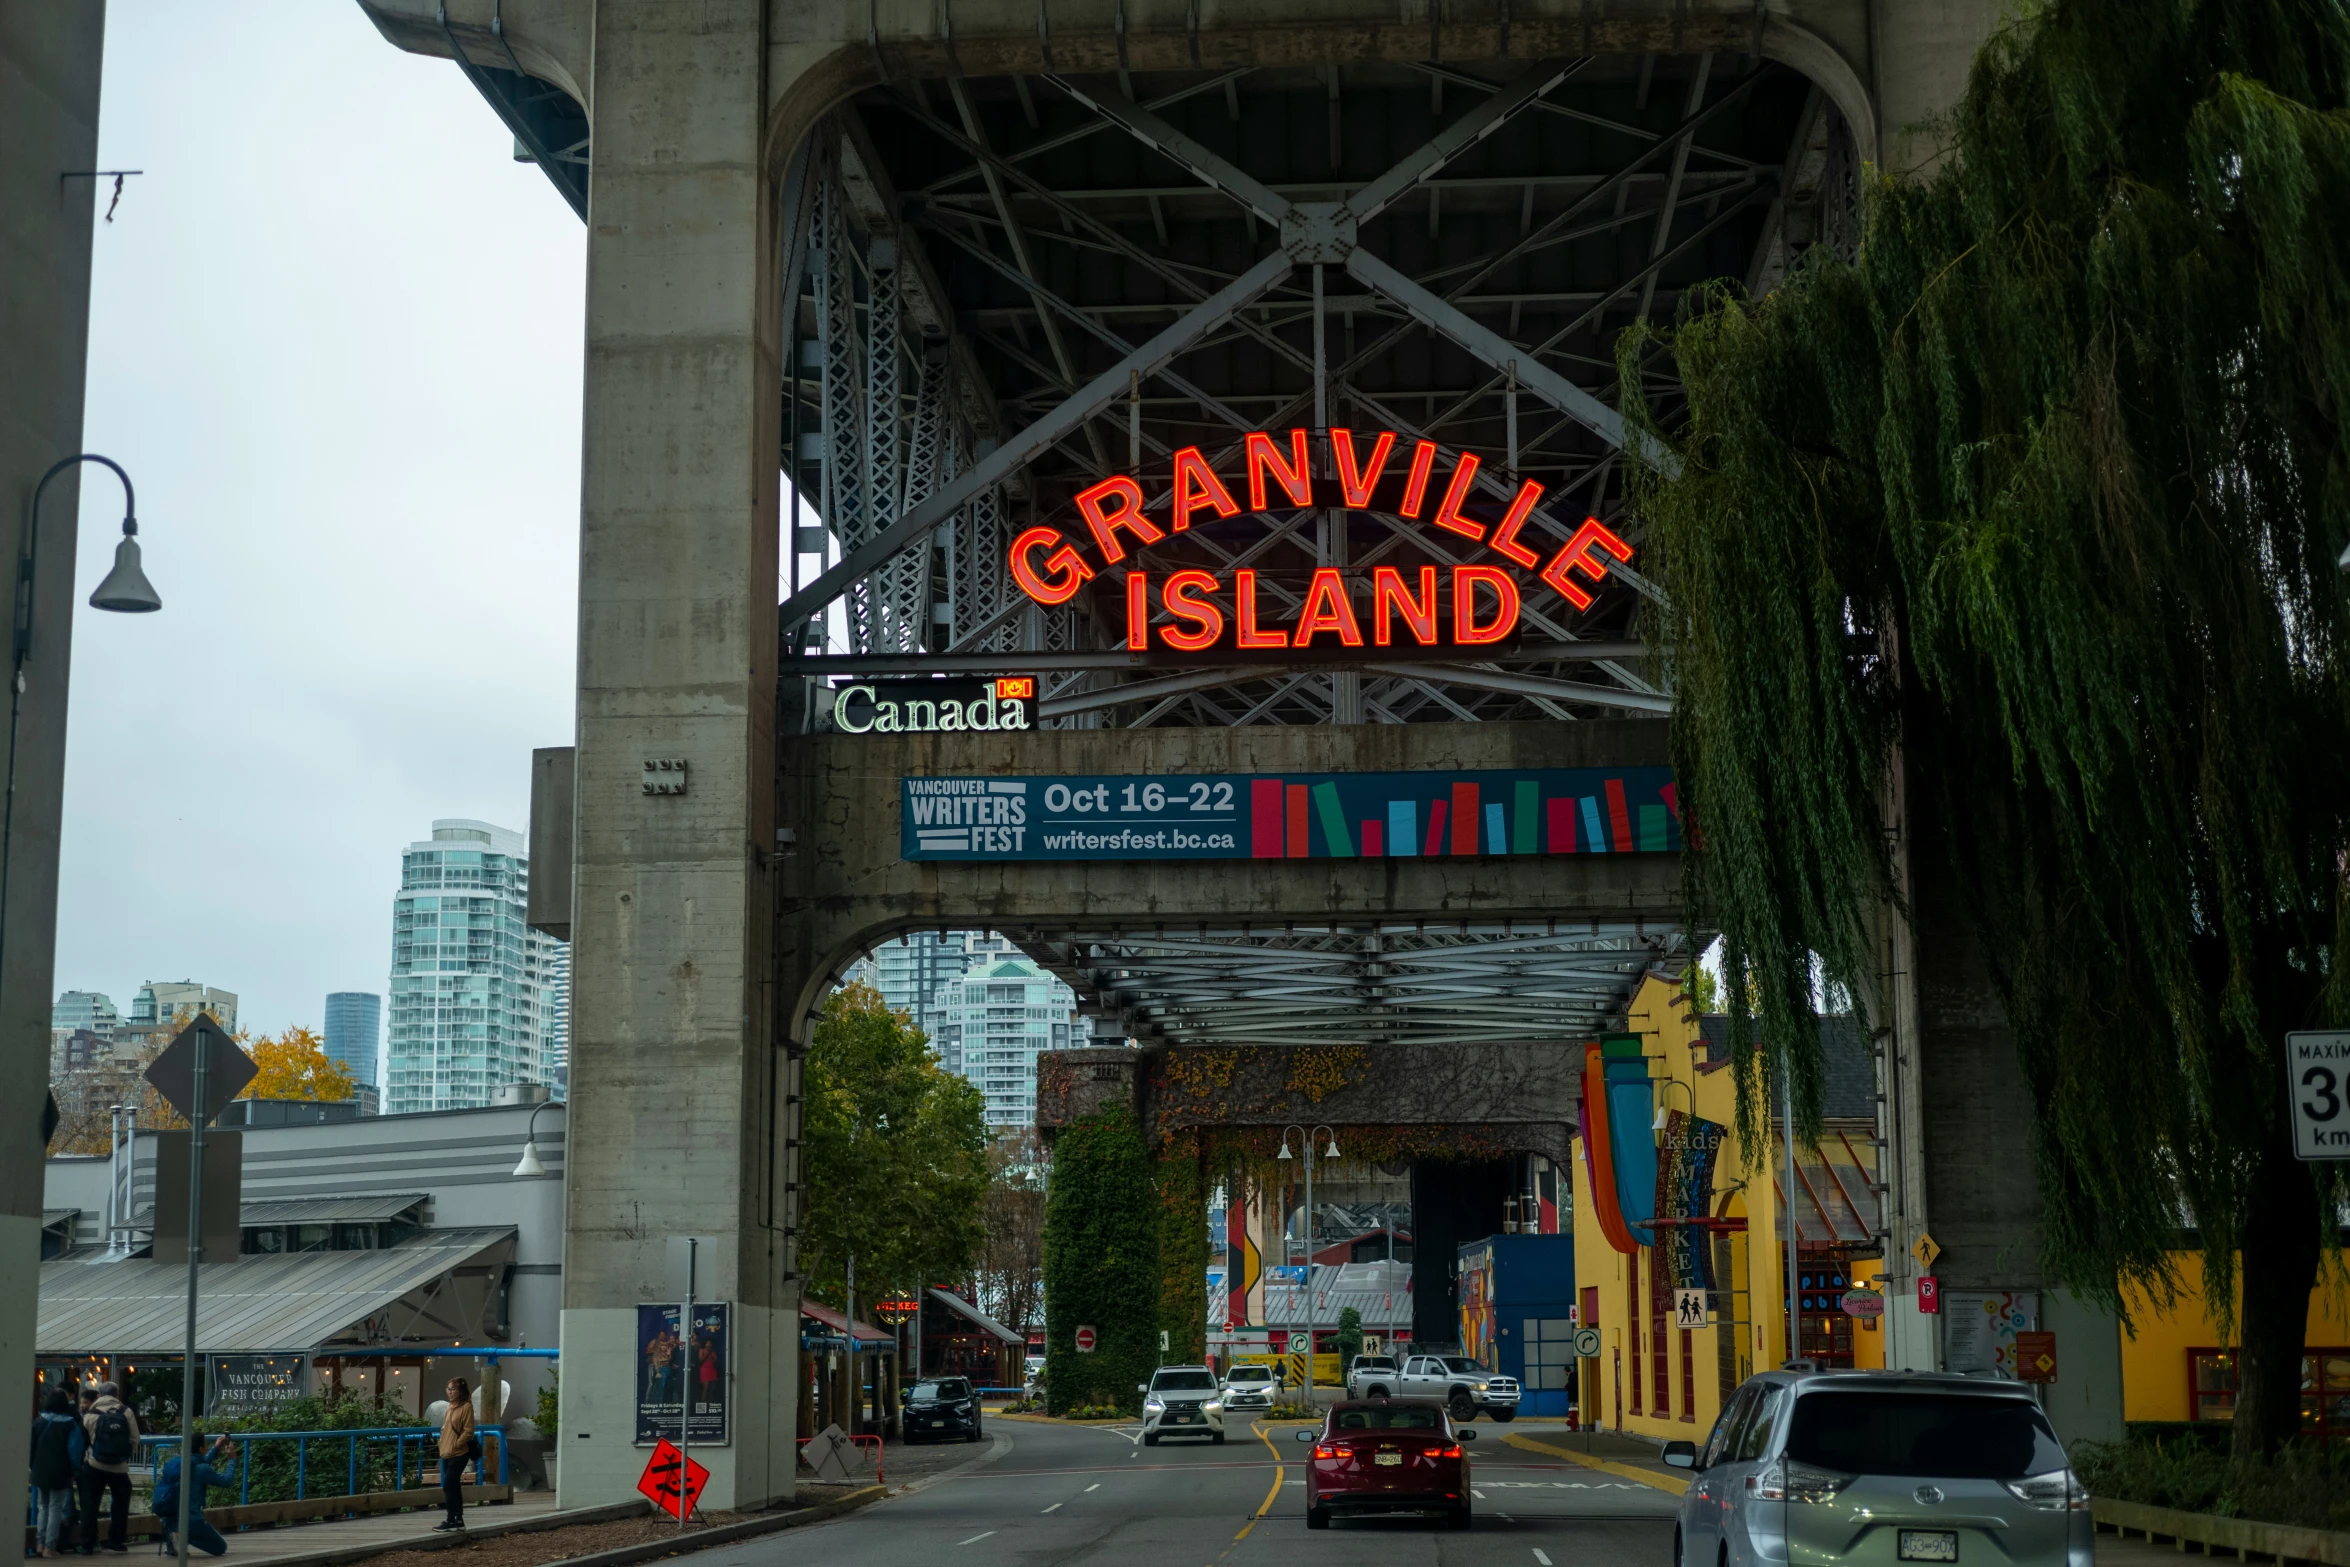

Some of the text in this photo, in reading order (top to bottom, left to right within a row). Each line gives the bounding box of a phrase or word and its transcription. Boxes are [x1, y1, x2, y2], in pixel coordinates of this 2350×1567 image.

[1008, 427, 1635, 613] GRANVILLE
[1126, 565, 1522, 651] ISLAND
[834, 682, 1031, 733] Canada
[908, 780, 985, 796] VANCOUVER
[1044, 783, 1109, 813] Oct
[911, 796, 1026, 825] WRITERS
[971, 826, 1026, 852] FEST
[1043, 828, 1235, 851] writersfest.bc.ca
[2302, 1066, 2350, 1122] 3
[1665, 1132, 1720, 1150] kids
[897, 1301, 919, 1311] KEG
[1844, 1295, 1872, 1306] Licorice
[1858, 1303, 1883, 1312] Parlour
[229, 1374, 294, 1385] VANCOUVER
[221, 1388, 300, 1400] FISH COMPANY
